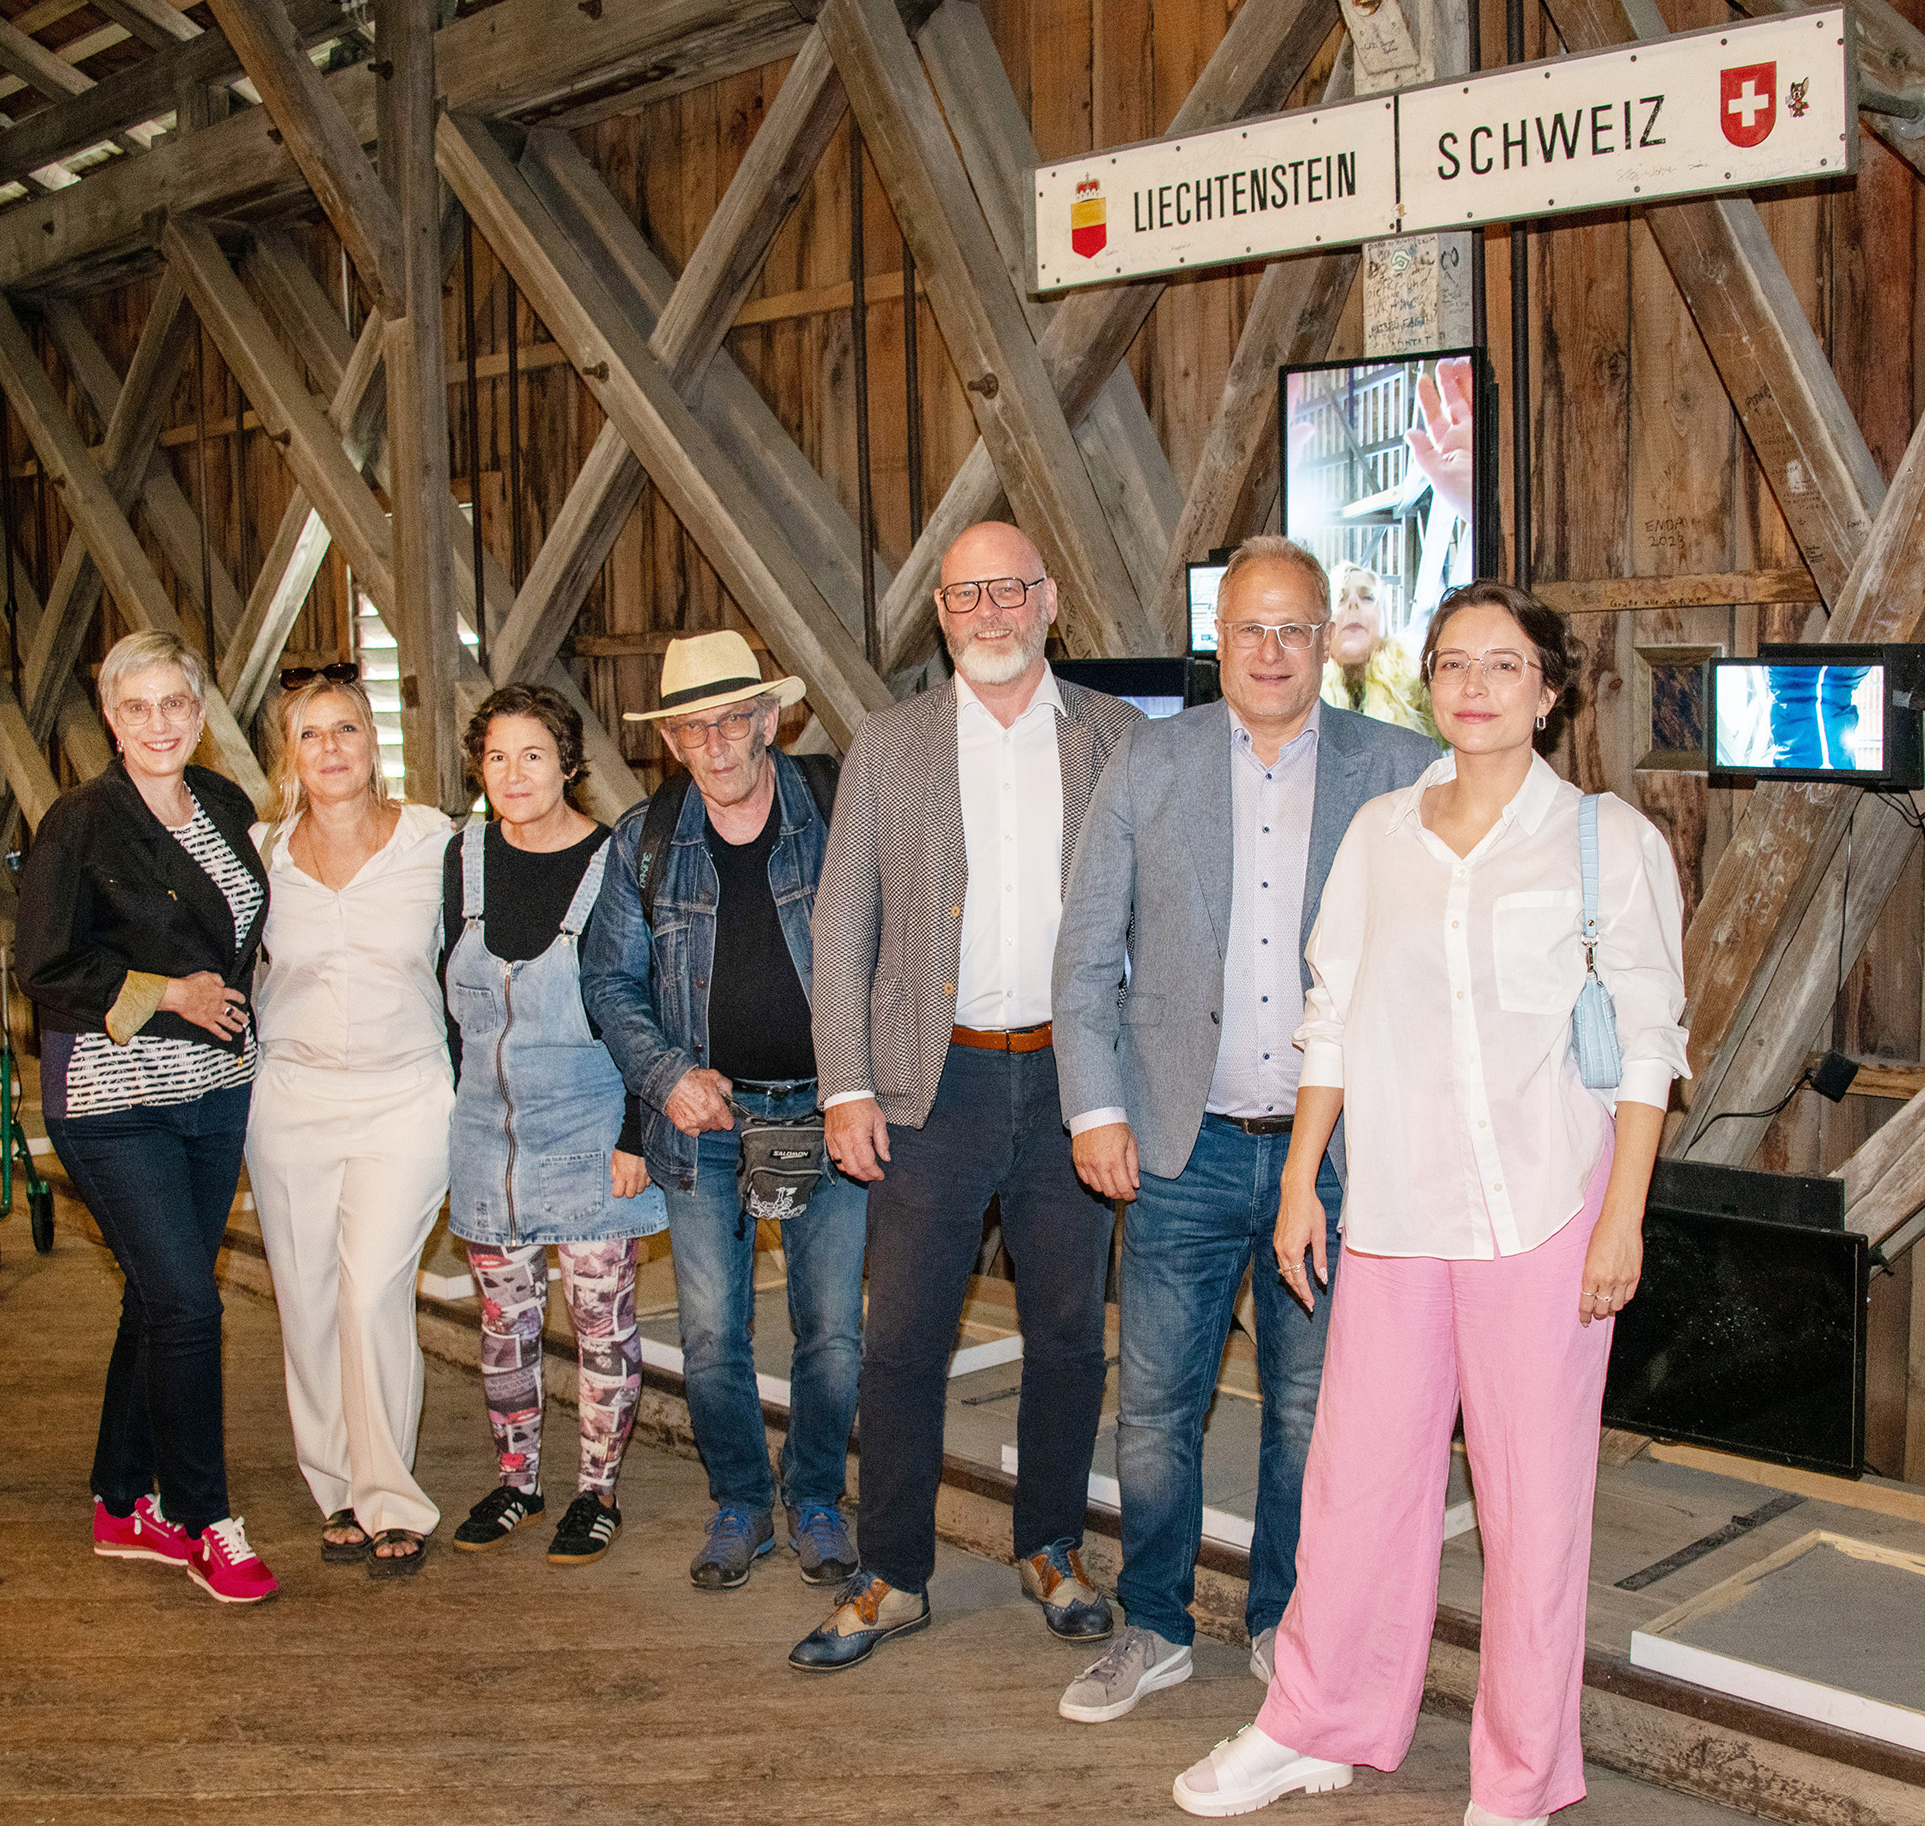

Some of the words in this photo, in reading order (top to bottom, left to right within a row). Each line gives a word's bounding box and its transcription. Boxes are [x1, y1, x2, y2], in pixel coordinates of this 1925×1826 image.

[1437, 94, 1666, 181] SCHWEIZ
[1134, 151, 1356, 233] LIECHTENSTEIN
[1648, 534, 1685, 549] 2023
[772, 1150, 809, 1158] SALOMON
